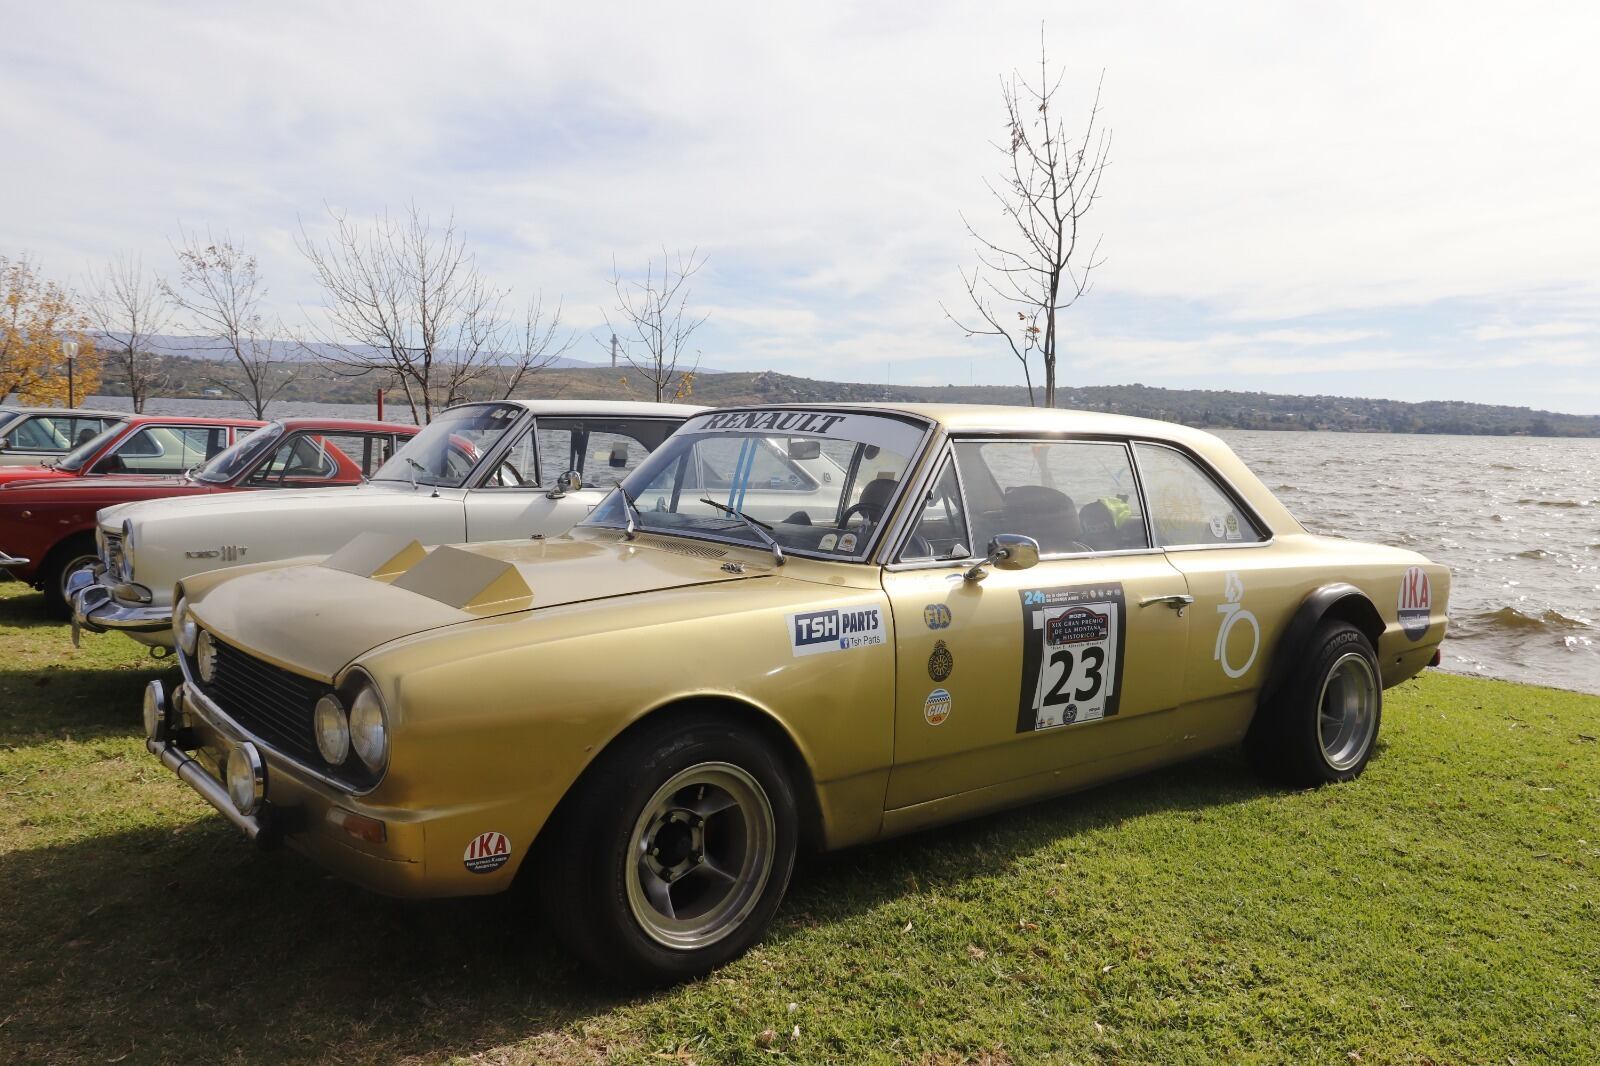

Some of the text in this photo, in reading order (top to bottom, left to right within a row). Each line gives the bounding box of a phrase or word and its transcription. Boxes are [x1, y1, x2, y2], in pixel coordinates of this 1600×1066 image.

[700, 412, 846, 434] RENAULT
[1402, 568, 1429, 608] IKA
[798, 610, 879, 640] TSH PARTS
[925, 607, 950, 626] FIA
[850, 635, 880, 647] Tsh Parts
[1043, 646, 1104, 707] 23
[470, 833, 507, 858] IKA
